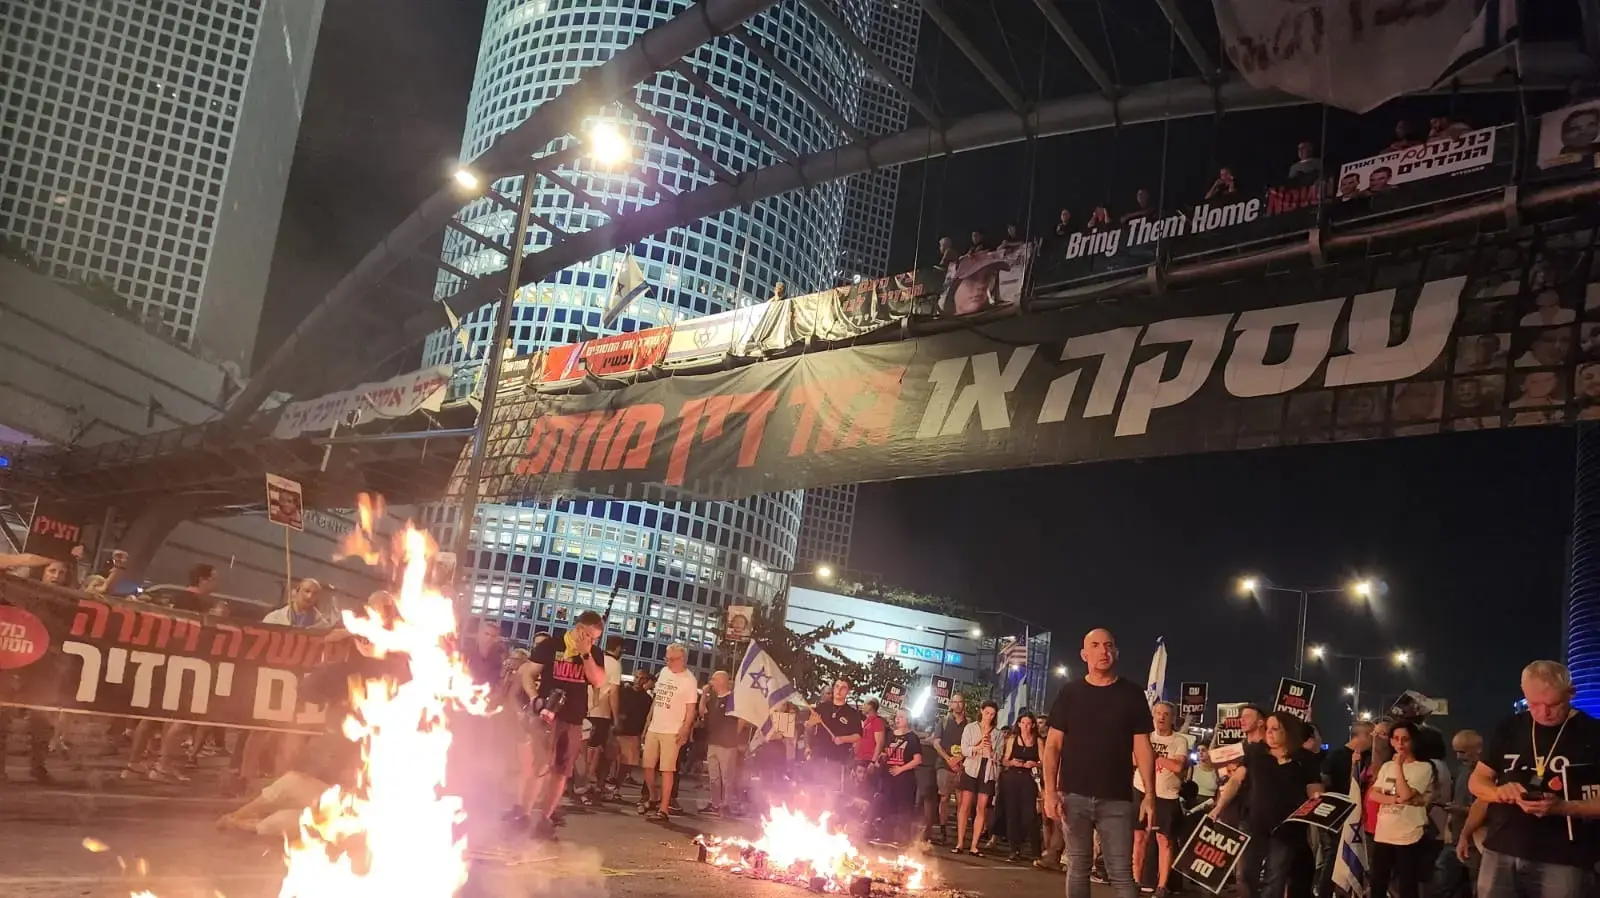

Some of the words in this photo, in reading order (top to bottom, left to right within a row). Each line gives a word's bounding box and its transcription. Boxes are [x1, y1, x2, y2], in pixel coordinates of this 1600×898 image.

[1397, 145, 1489, 176] הנהדרים
[1432, 131, 1491, 156] כולנו
[1066, 227, 1121, 260] Bring
[1127, 213, 1187, 247] Them
[1191, 198, 1260, 234] Home
[1037, 275, 1467, 437] עסקה
[915, 344, 1040, 439] או
[664, 390, 779, 486] דין
[70, 599, 201, 651] ויתרה
[62, 640, 235, 714] יחזיר
[1289, 685, 1304, 697] עם
[1226, 708, 1239, 718] עם
